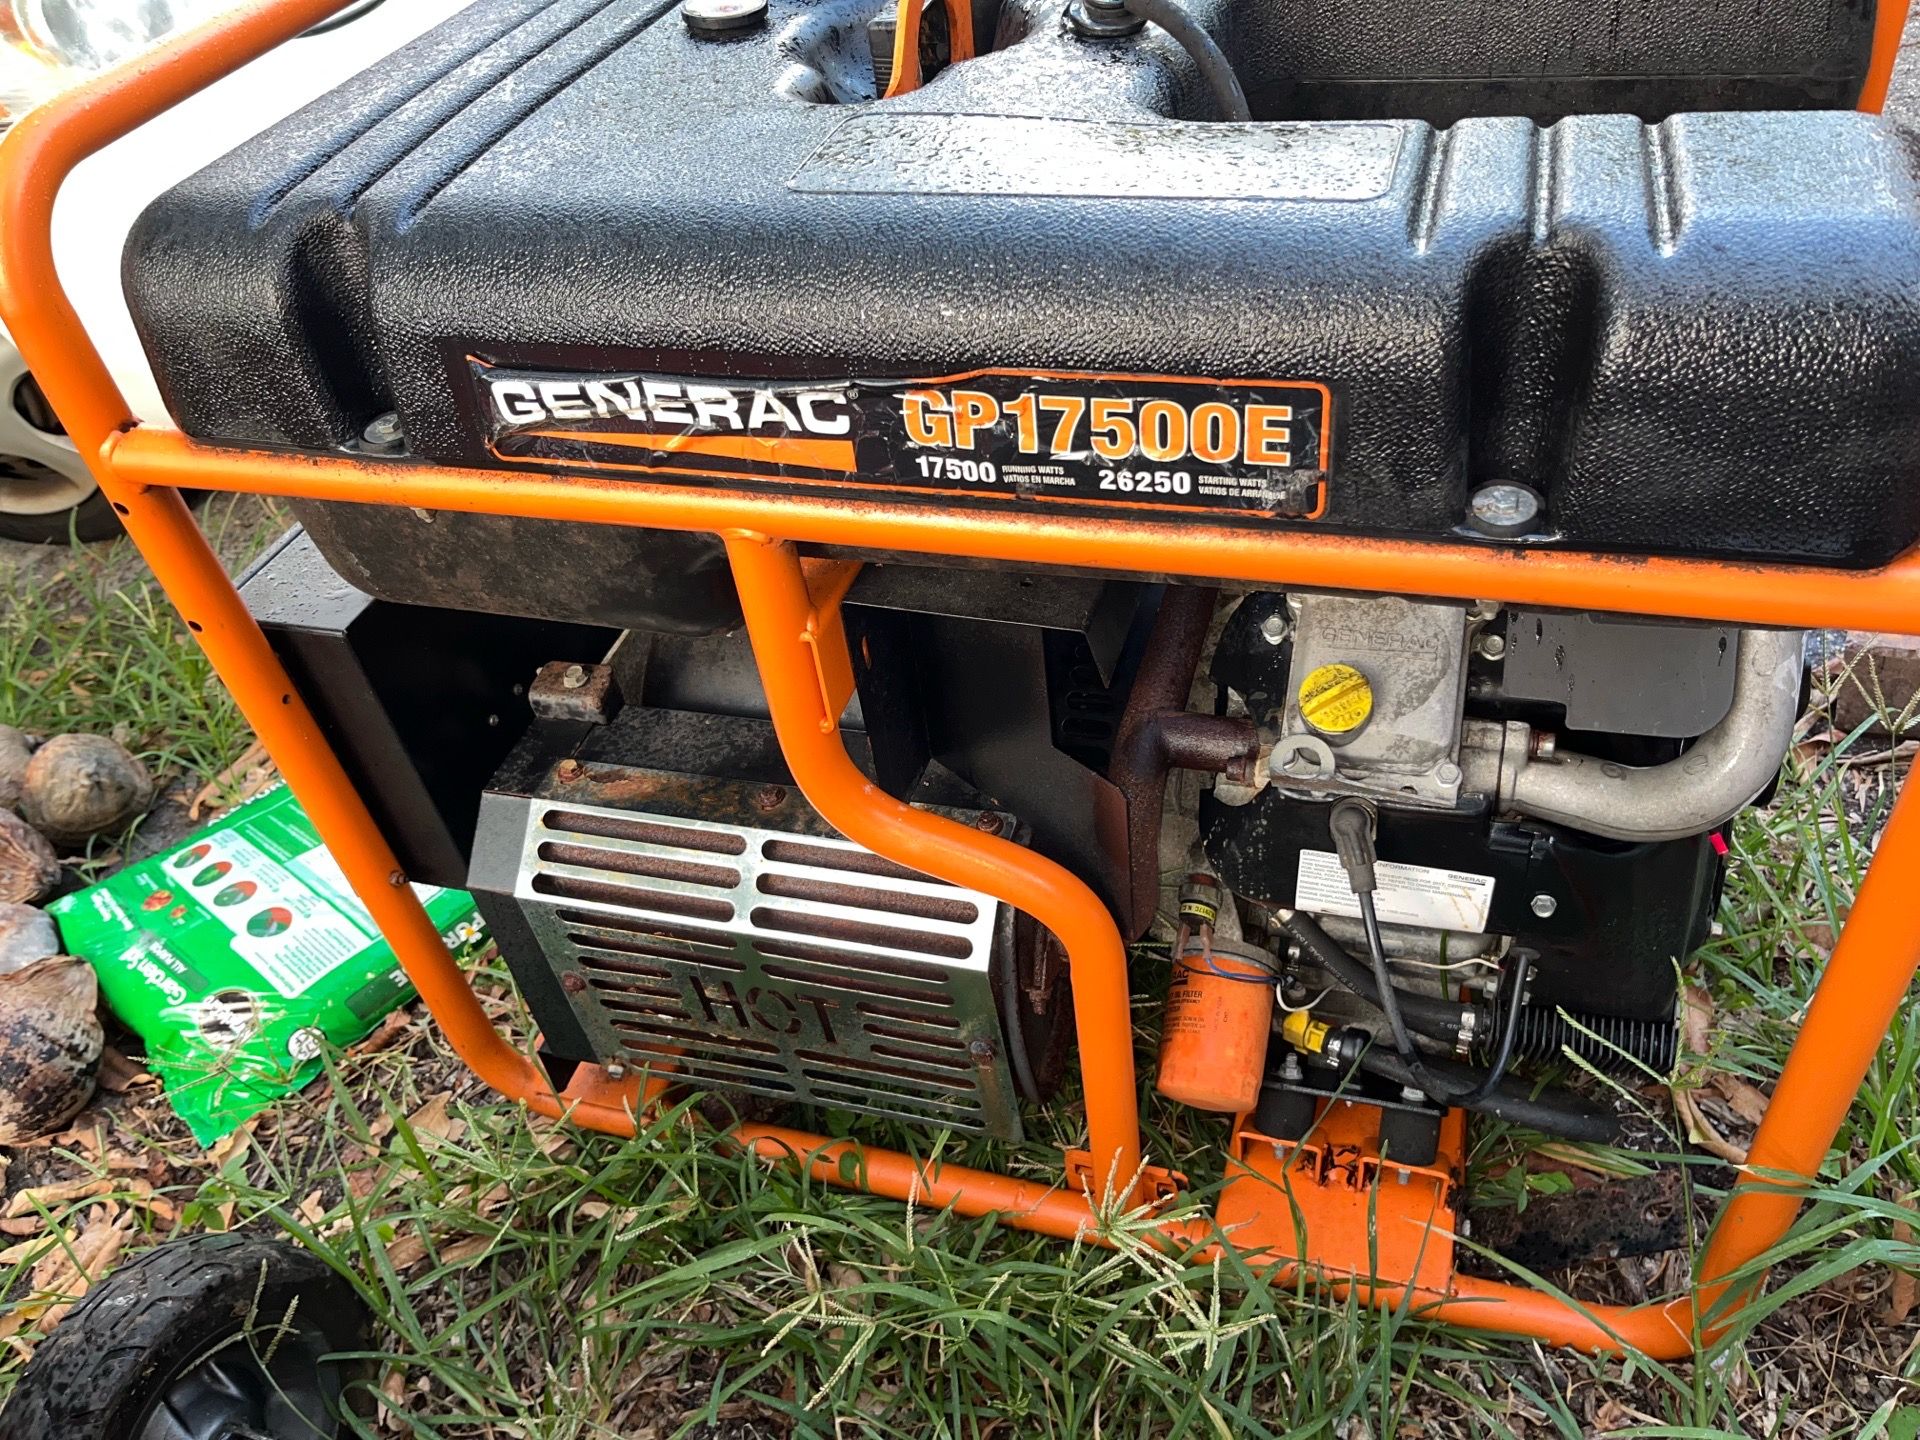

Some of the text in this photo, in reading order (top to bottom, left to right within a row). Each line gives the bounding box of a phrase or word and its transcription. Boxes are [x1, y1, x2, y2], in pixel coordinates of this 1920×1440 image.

[491, 380, 851, 435] GENERAC
[902, 389, 1292, 466] GP17500E
[915, 456, 997, 484] 17500
[1002, 465, 1065, 475] RUNNING WATTS
[1003, 475, 1076, 487] VATIOS EN MARCHA
[1099, 469, 1191, 495] 26250
[1198, 475, 1267, 489] STARTING WATTS
[1198, 486, 1227, 496] VATIOS
[1229, 488, 1240, 497] DE
[1321, 627, 1440, 650] GENERAC
[1377, 862, 1430, 874] INFORMATION
[1447, 873, 1487, 884] GENERAC
[168, 958, 189, 975] ALL
[136, 957, 188, 1006] Garden
[1182, 990, 1203, 999] FILTER
[689, 974, 840, 1044] HOT
